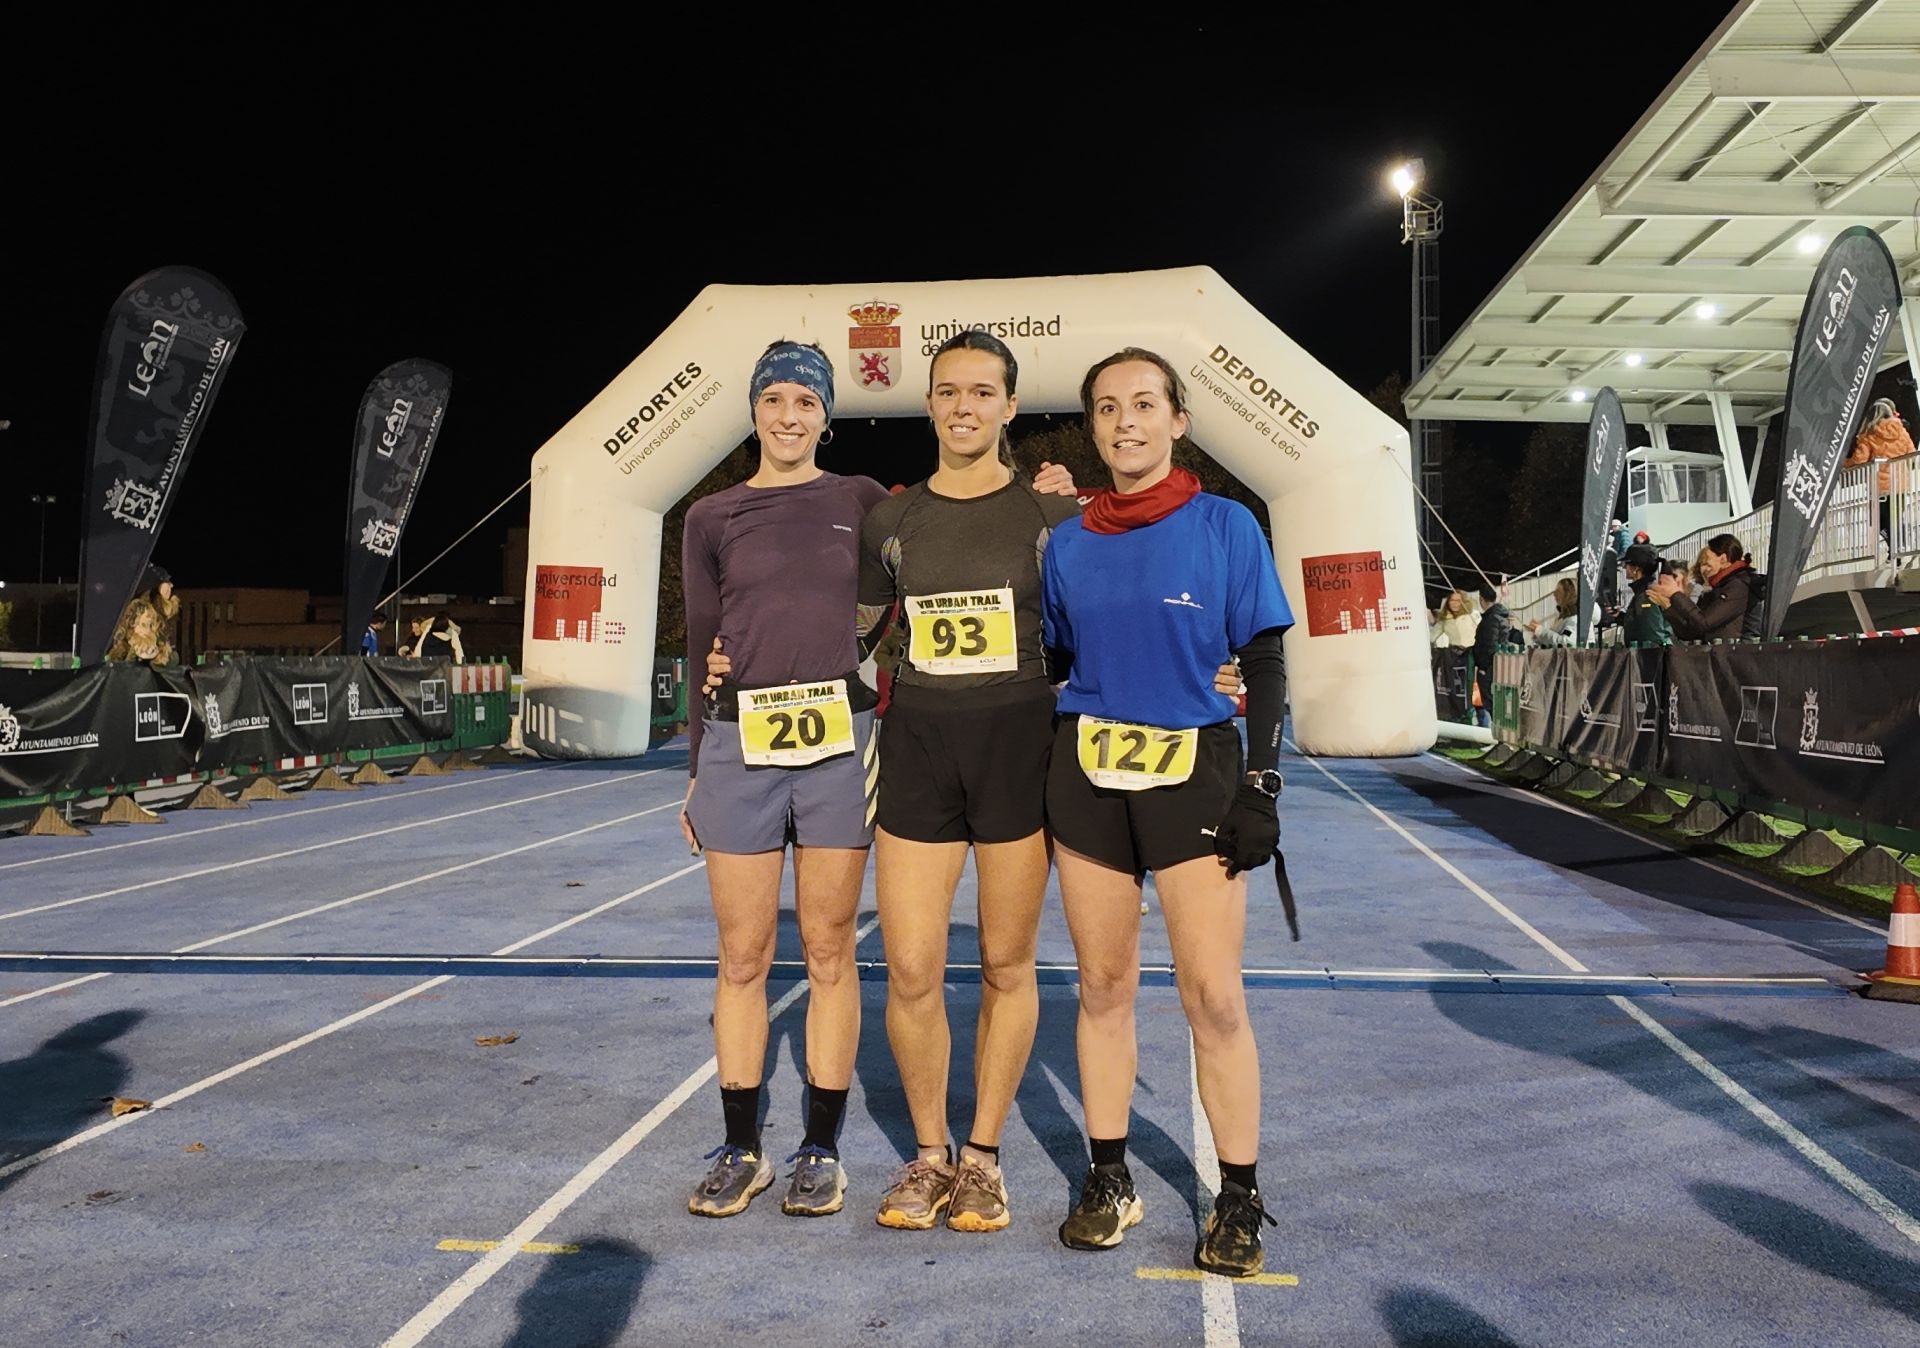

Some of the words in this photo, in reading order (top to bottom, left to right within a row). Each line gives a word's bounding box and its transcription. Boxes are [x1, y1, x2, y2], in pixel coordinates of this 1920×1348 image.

[603, 362, 702, 456] DEPORTES
[1209, 344, 1320, 439] DEPORTES
[1821, 364, 1866, 478] AYUNTAMIENTO
[1861, 342, 1874, 362] DE
[1870, 304, 1888, 341] LEÓN
[158, 391, 203, 489] AYUNTAMIENTO
[199, 373, 212, 392] DE
[206, 337, 226, 371] LEÓN
[1190, 364, 1256, 423] Universidad
[1255, 421, 1270, 436] de
[1271, 432, 1301, 461] León
[620, 418, 682, 475] Universidad
[680, 406, 696, 421] de
[536, 571, 617, 587] universidad
[1302, 556, 1397, 578] universidad
[1316, 575, 1352, 591] león
[935, 596, 967, 608] URBAN
[970, 594, 1001, 606] TRAIL
[932, 617, 987, 657] 93
[769, 688, 805, 703] URBAN
[807, 685, 835, 698] TRAIL
[139, 707, 158, 723] LEÓN
[766, 708, 825, 750] 20
[19, 736, 73, 750] AYUNTAMIENTO
[1090, 728, 1183, 773] 127
[1855, 744, 1864, 755] DE
[1864, 741, 1883, 757] LEÓN
